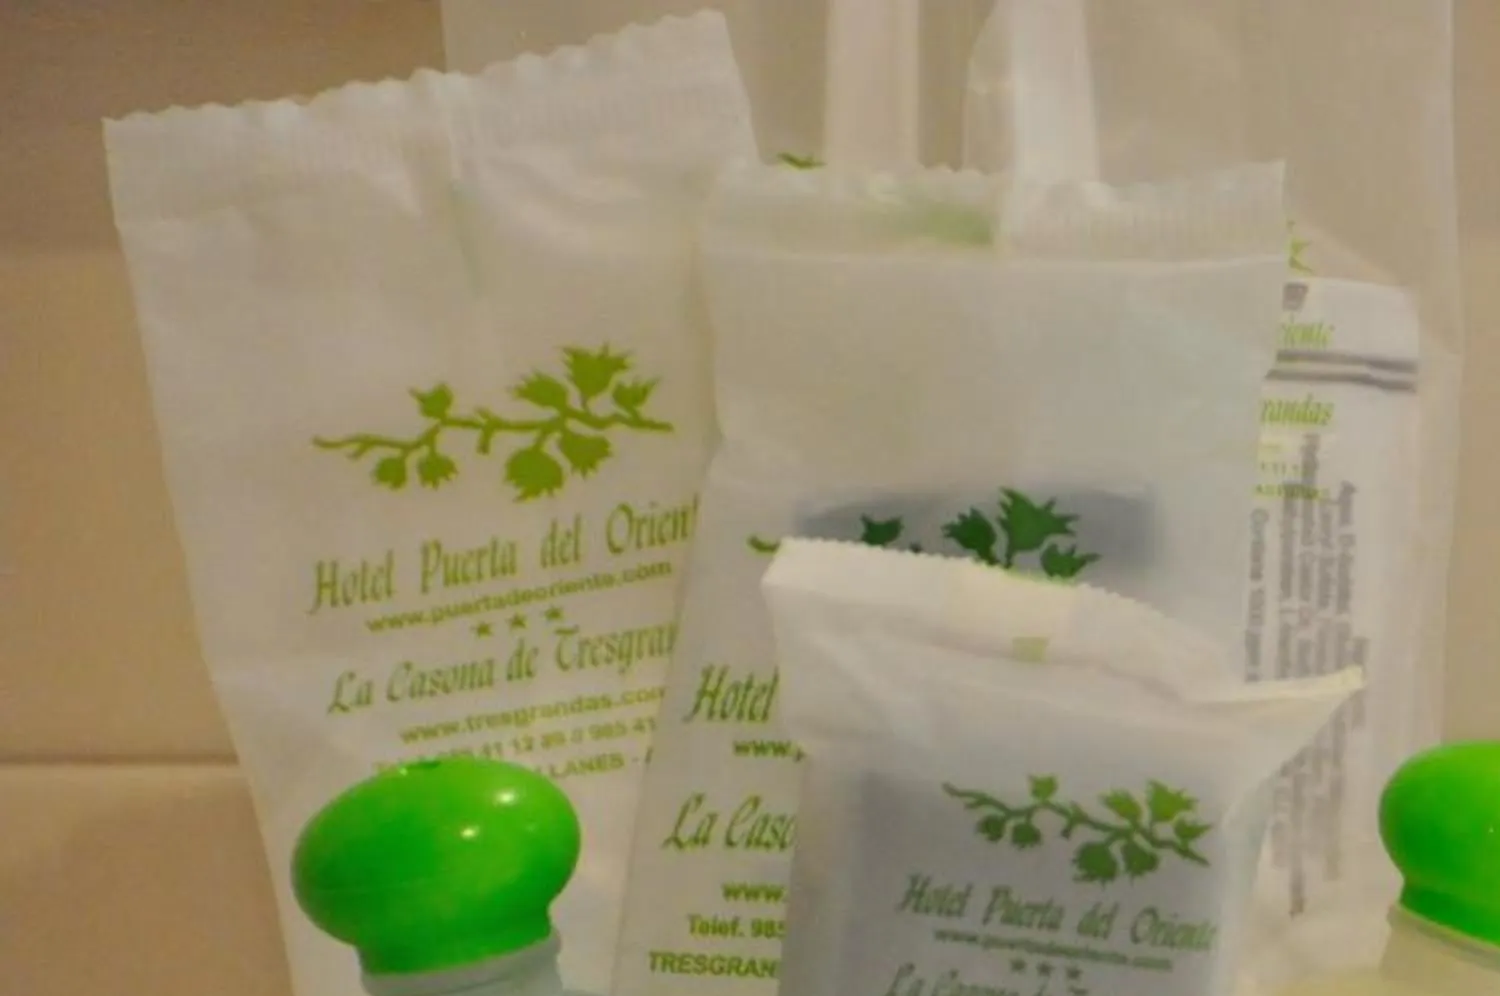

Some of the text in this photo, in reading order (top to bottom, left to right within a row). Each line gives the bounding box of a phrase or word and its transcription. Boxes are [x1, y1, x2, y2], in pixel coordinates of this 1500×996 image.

[307, 549, 396, 615] Hotel
[420, 536, 520, 595] Puerta
[540, 512, 583, 569] del
[365, 560, 673, 634] www.puertadeoriente.com
[327, 669, 374, 715] La
[385, 660, 496, 704] Casona
[505, 636, 540, 682] de
[680, 663, 781, 724] Hotel
[661, 791, 720, 850] La
[896, 872, 974, 918] Hotel
[982, 884, 1065, 932] Puerta
[1076, 901, 1119, 941] del
